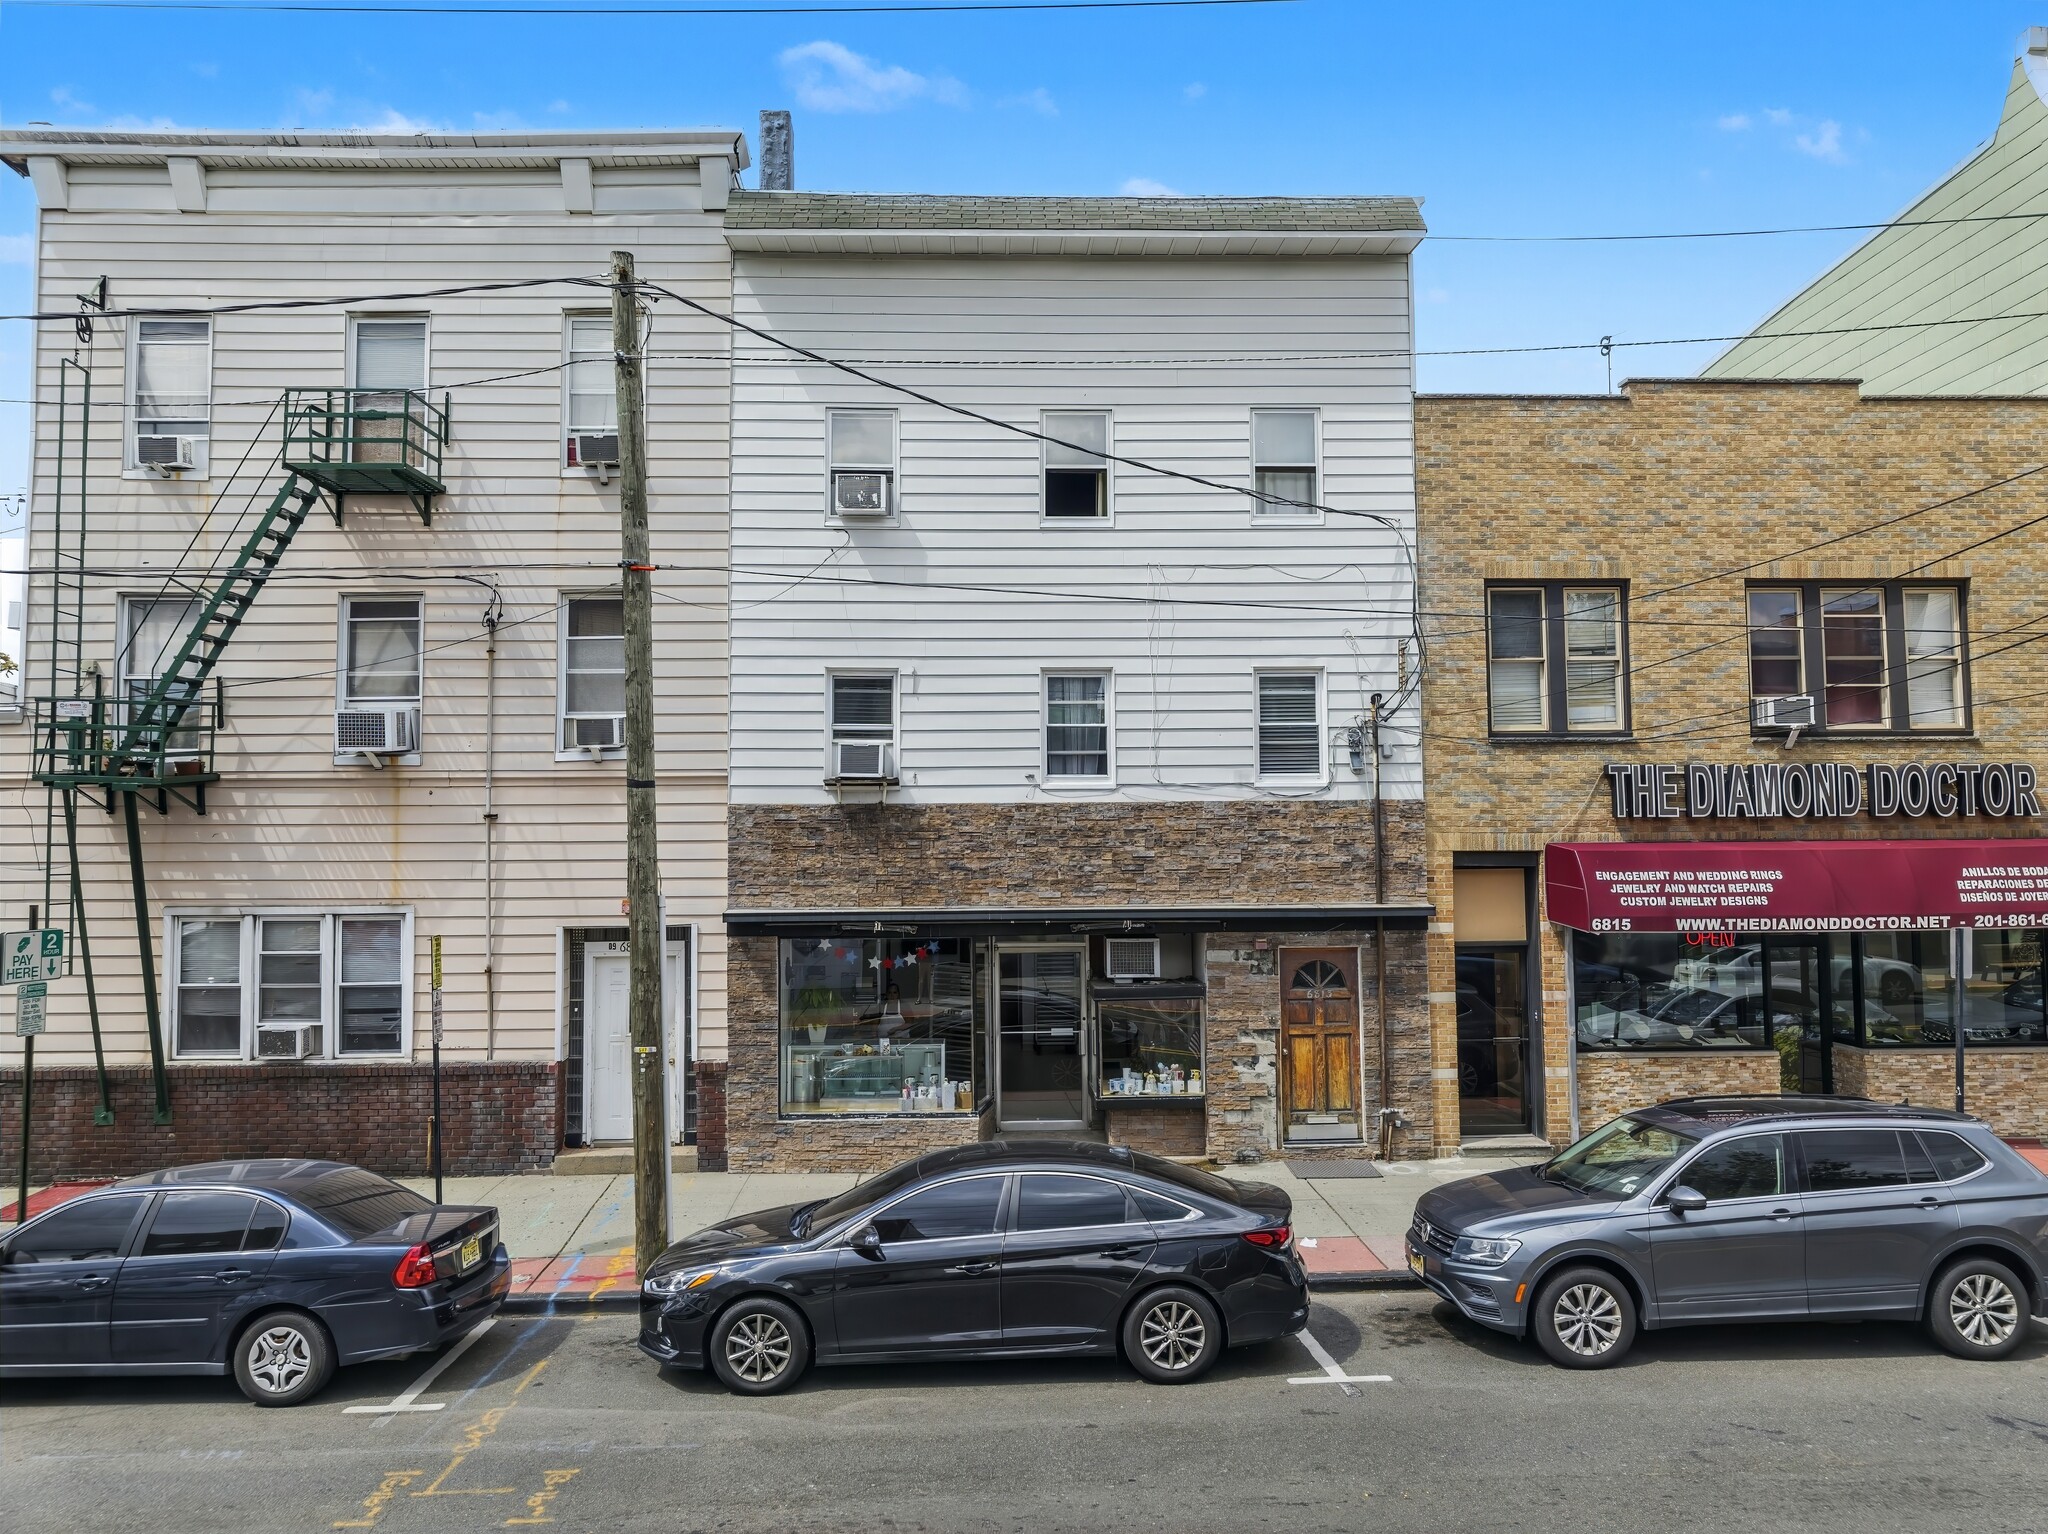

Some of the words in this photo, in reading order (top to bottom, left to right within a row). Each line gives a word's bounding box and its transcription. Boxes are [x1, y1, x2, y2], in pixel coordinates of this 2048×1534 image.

[1606, 764, 1680, 818] THE
[1686, 763, 1862, 818] DIAMOND
[1870, 762, 2041, 818] DOCTOR
[1595, 871, 1670, 881] ENGAGEMENT
[1673, 871, 1695, 881] AND
[1697, 870, 1749, 880] WEDDING
[1750, 870, 1783, 880] RINGS
[1962, 867, 2006, 877] ANILLOS
[2007, 867, 2021, 876] DE
[1610, 884, 1661, 893] JEWELRY
[1664, 883, 1686, 893] AND
[1688, 883, 1726, 893] WATCH
[1728, 883, 1774, 893] REPAIRS
[1956, 879, 2034, 890] REPARACIONES
[2036, 879, 2048, 889] DE
[1620, 896, 1666, 906] CUSTOM
[1669, 896, 1718, 906] JEWELRY
[1720, 896, 1769, 906] DESIGNS
[1959, 891, 2003, 902] DISEÑOS
[2004, 892, 2018, 902] DE
[2019, 891, 2048, 901] JOYER
[1591, 918, 1631, 931] 6815
[1675, 915, 1950, 931] WWW.THEDIAMONDDOCTOR.NET
[47, 933, 57, 949] 2
[1686, 931, 1734, 948] OPEN
[13, 954, 34, 967] PAY
[6, 966, 39, 980] HERE
